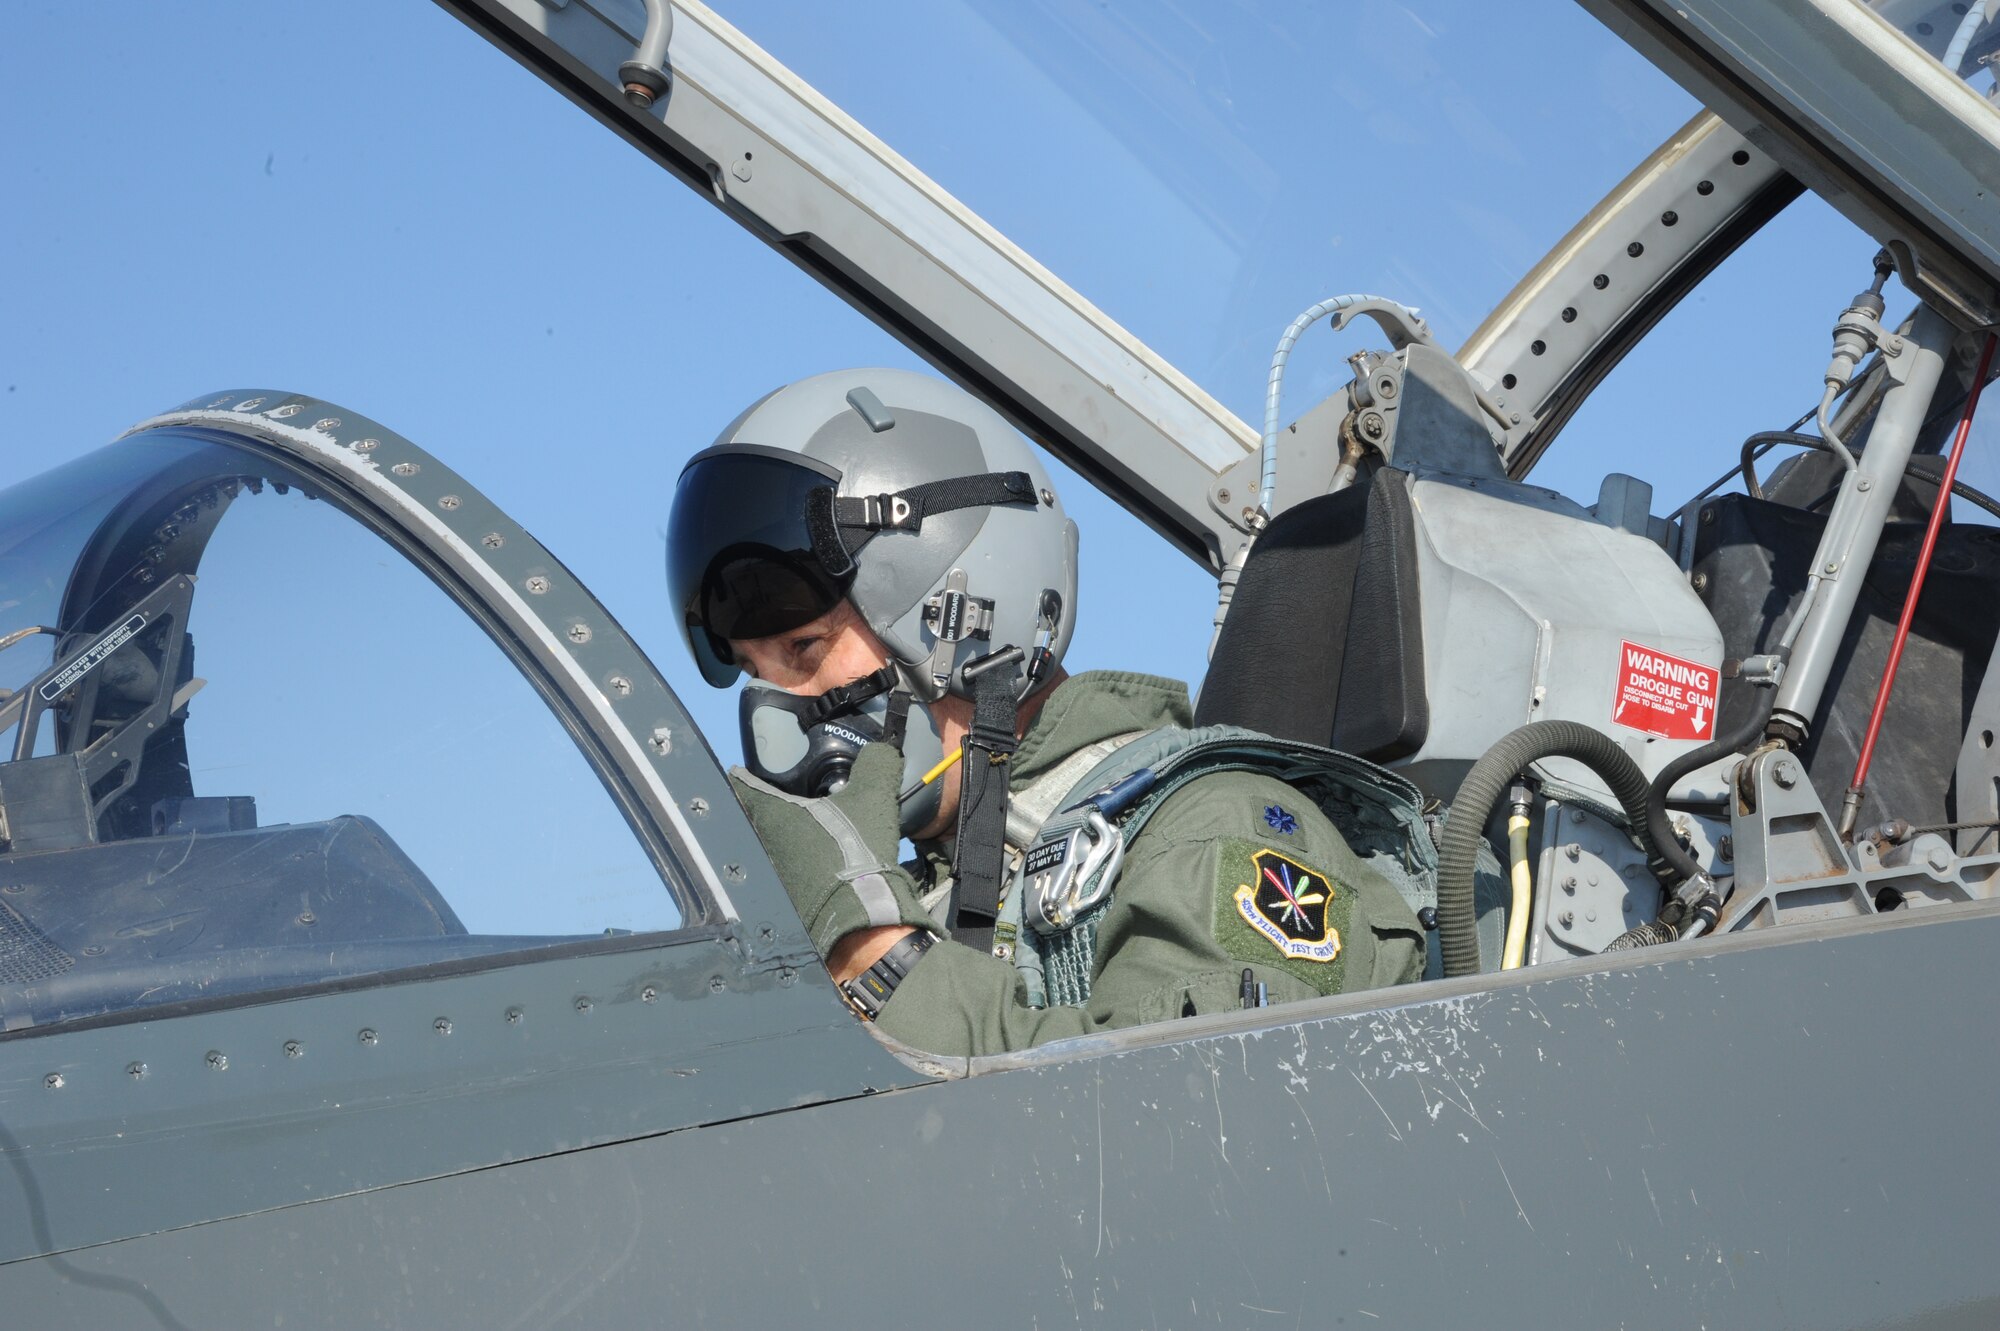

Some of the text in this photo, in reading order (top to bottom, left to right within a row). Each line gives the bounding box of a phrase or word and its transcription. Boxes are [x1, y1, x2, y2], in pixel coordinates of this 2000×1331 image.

[949, 593, 959, 627] WOODARD
[55, 625, 130, 684] CLEAN GLASS WITH ISOPROPYL
[59, 669, 83, 689] ALCOHOL
[101, 643, 115, 656] LENS
[115, 630, 132, 645] TISSUE
[1626, 648, 1709, 691] WARNING
[1622, 693, 1675, 715] HOSE TO DISARM
[1623, 685, 1688, 711] DISCONNECT OR CUT
[1629, 672, 1714, 710] DROGUE GUN
[824, 723, 870, 746] WOODAR
[1027, 841, 1066, 863] 30 DAY DUE
[1028, 852, 1062, 871] 27 MAY 12
[1257, 918, 1288, 948] FLIGHT
[1291, 943, 1311, 955] TEST
[1314, 941, 1335, 957] GROUP
